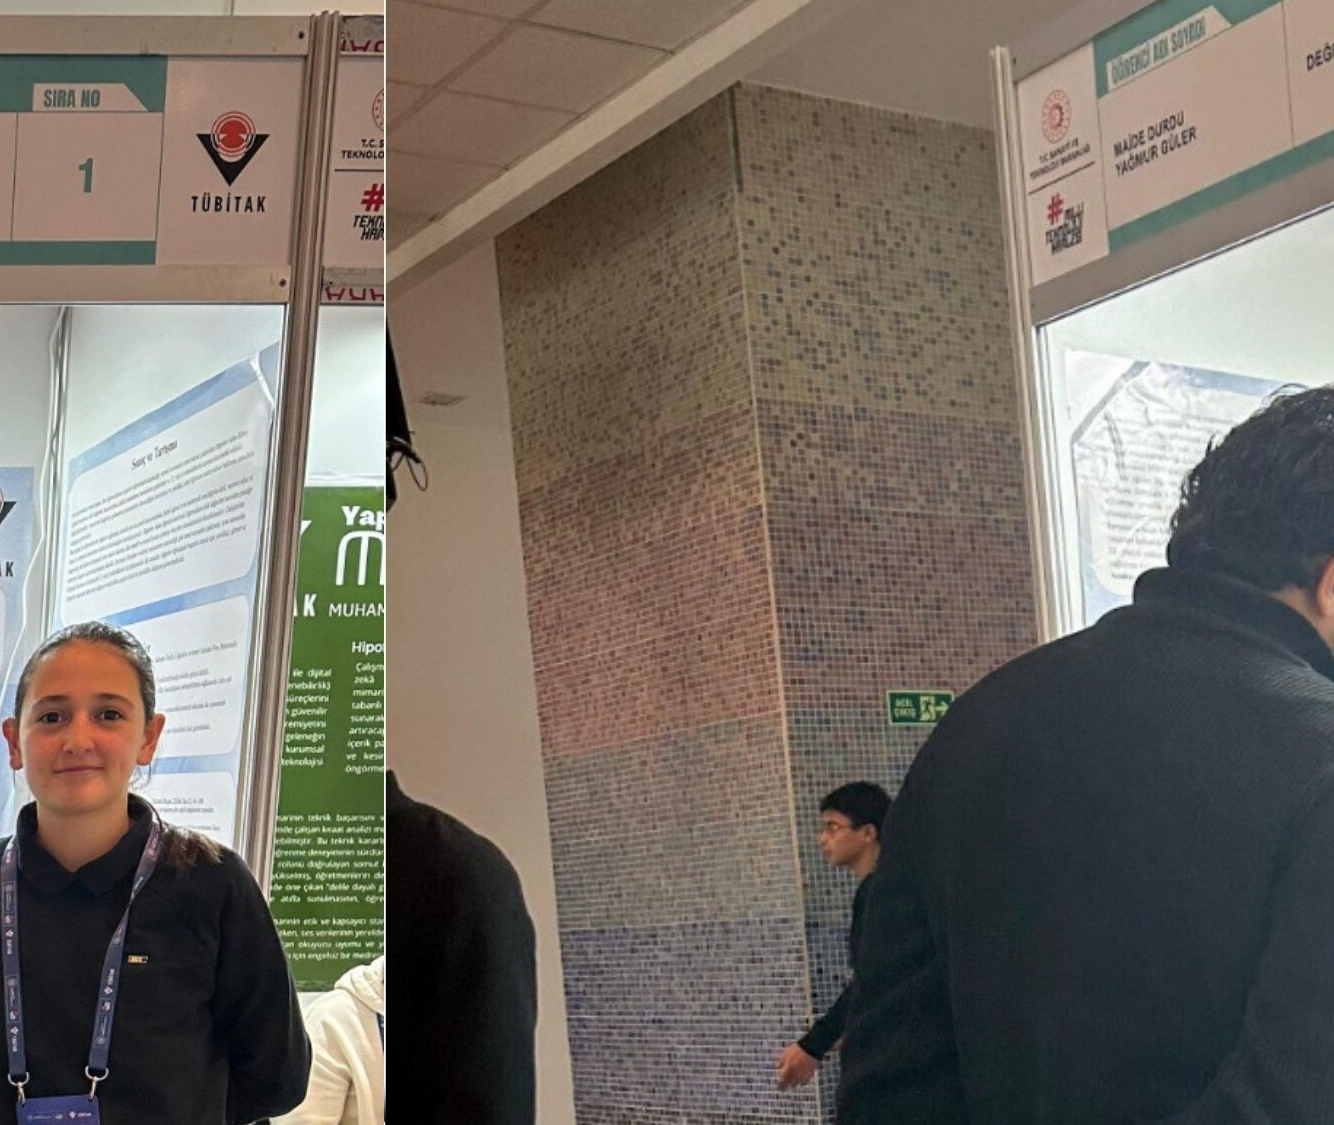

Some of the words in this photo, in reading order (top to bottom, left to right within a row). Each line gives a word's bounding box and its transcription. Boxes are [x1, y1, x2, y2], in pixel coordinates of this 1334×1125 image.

[44, 89, 77, 107] SIRA
[81, 89, 100, 107] NO
[1114, 129, 1146, 158] MAİDE
[1147, 110, 1185, 141] DURDU
[1115, 145, 1158, 177] YAĞMUR
[1161, 126, 1197, 155] GÜLER
[78, 158, 94, 193] 1
[192, 192, 266, 214] TÜBİTAK
